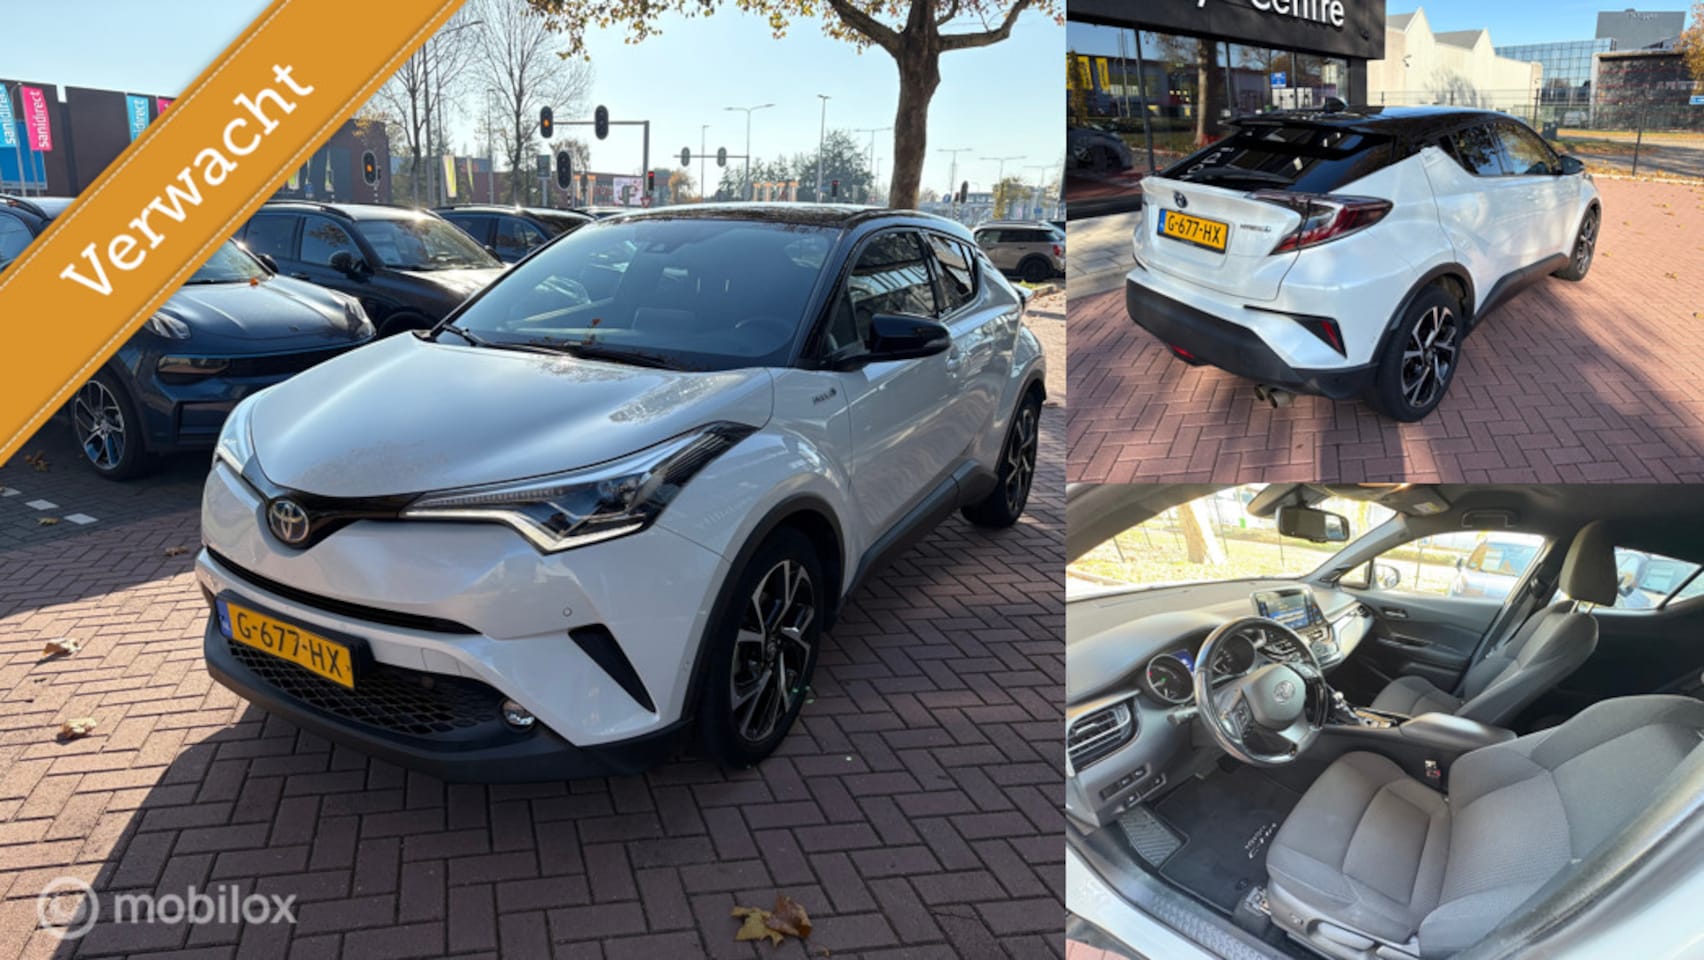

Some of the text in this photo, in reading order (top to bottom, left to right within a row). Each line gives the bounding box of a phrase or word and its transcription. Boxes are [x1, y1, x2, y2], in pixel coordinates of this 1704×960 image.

[1252, 0, 1345, 26] entre
[29, 91, 49, 148] sanidirect
[1168, 215, 1222, 244] G-677-HX
[237, 612, 343, 678] G-677-HX
